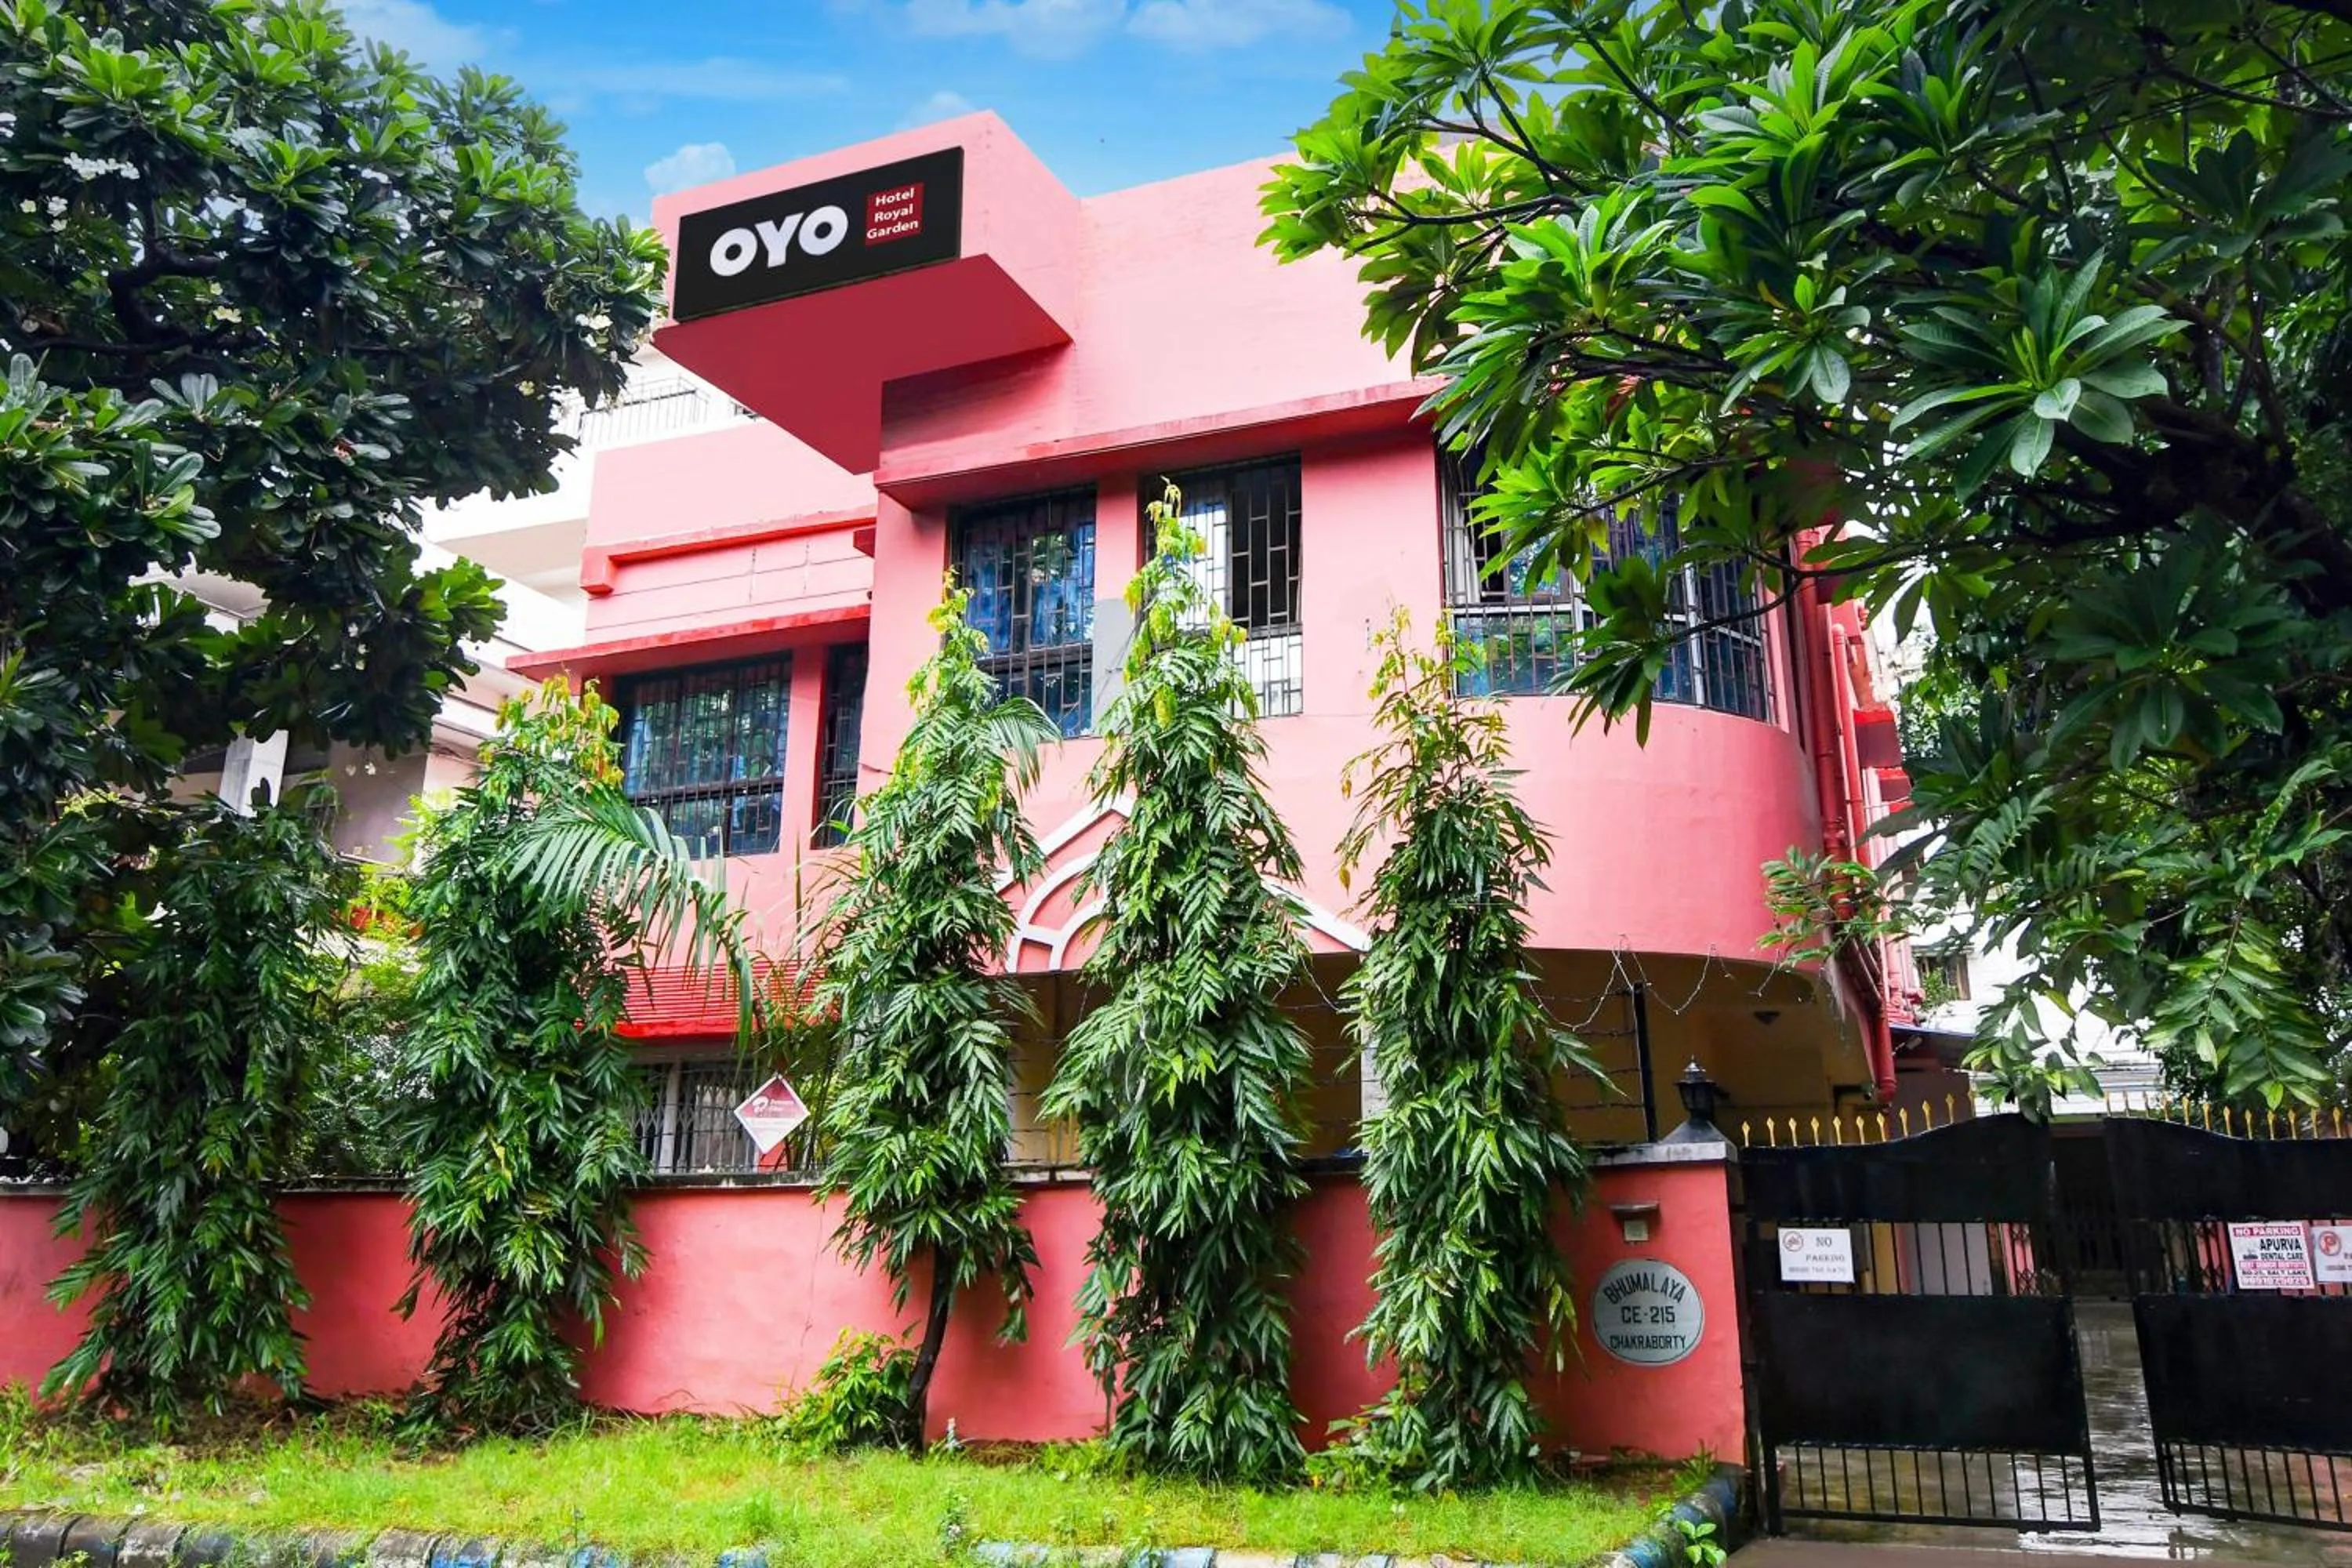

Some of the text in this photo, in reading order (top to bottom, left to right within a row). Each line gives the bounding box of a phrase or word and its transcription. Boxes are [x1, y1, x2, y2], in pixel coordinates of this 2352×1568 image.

[875, 187, 915, 207] Hotel
[874, 203, 913, 223] Royal
[866, 220, 919, 239] Garden
[710, 205, 848, 277] OYO
[2234, 1227, 2299, 1236] NO PARKING
[1816, 1237, 1832, 1247] NO
[2260, 1238, 2303, 1251] APURVA
[1602, 1272, 1686, 1305] BHUMALAYA
[1610, 1334, 1686, 1350] CHAKRABORTY
